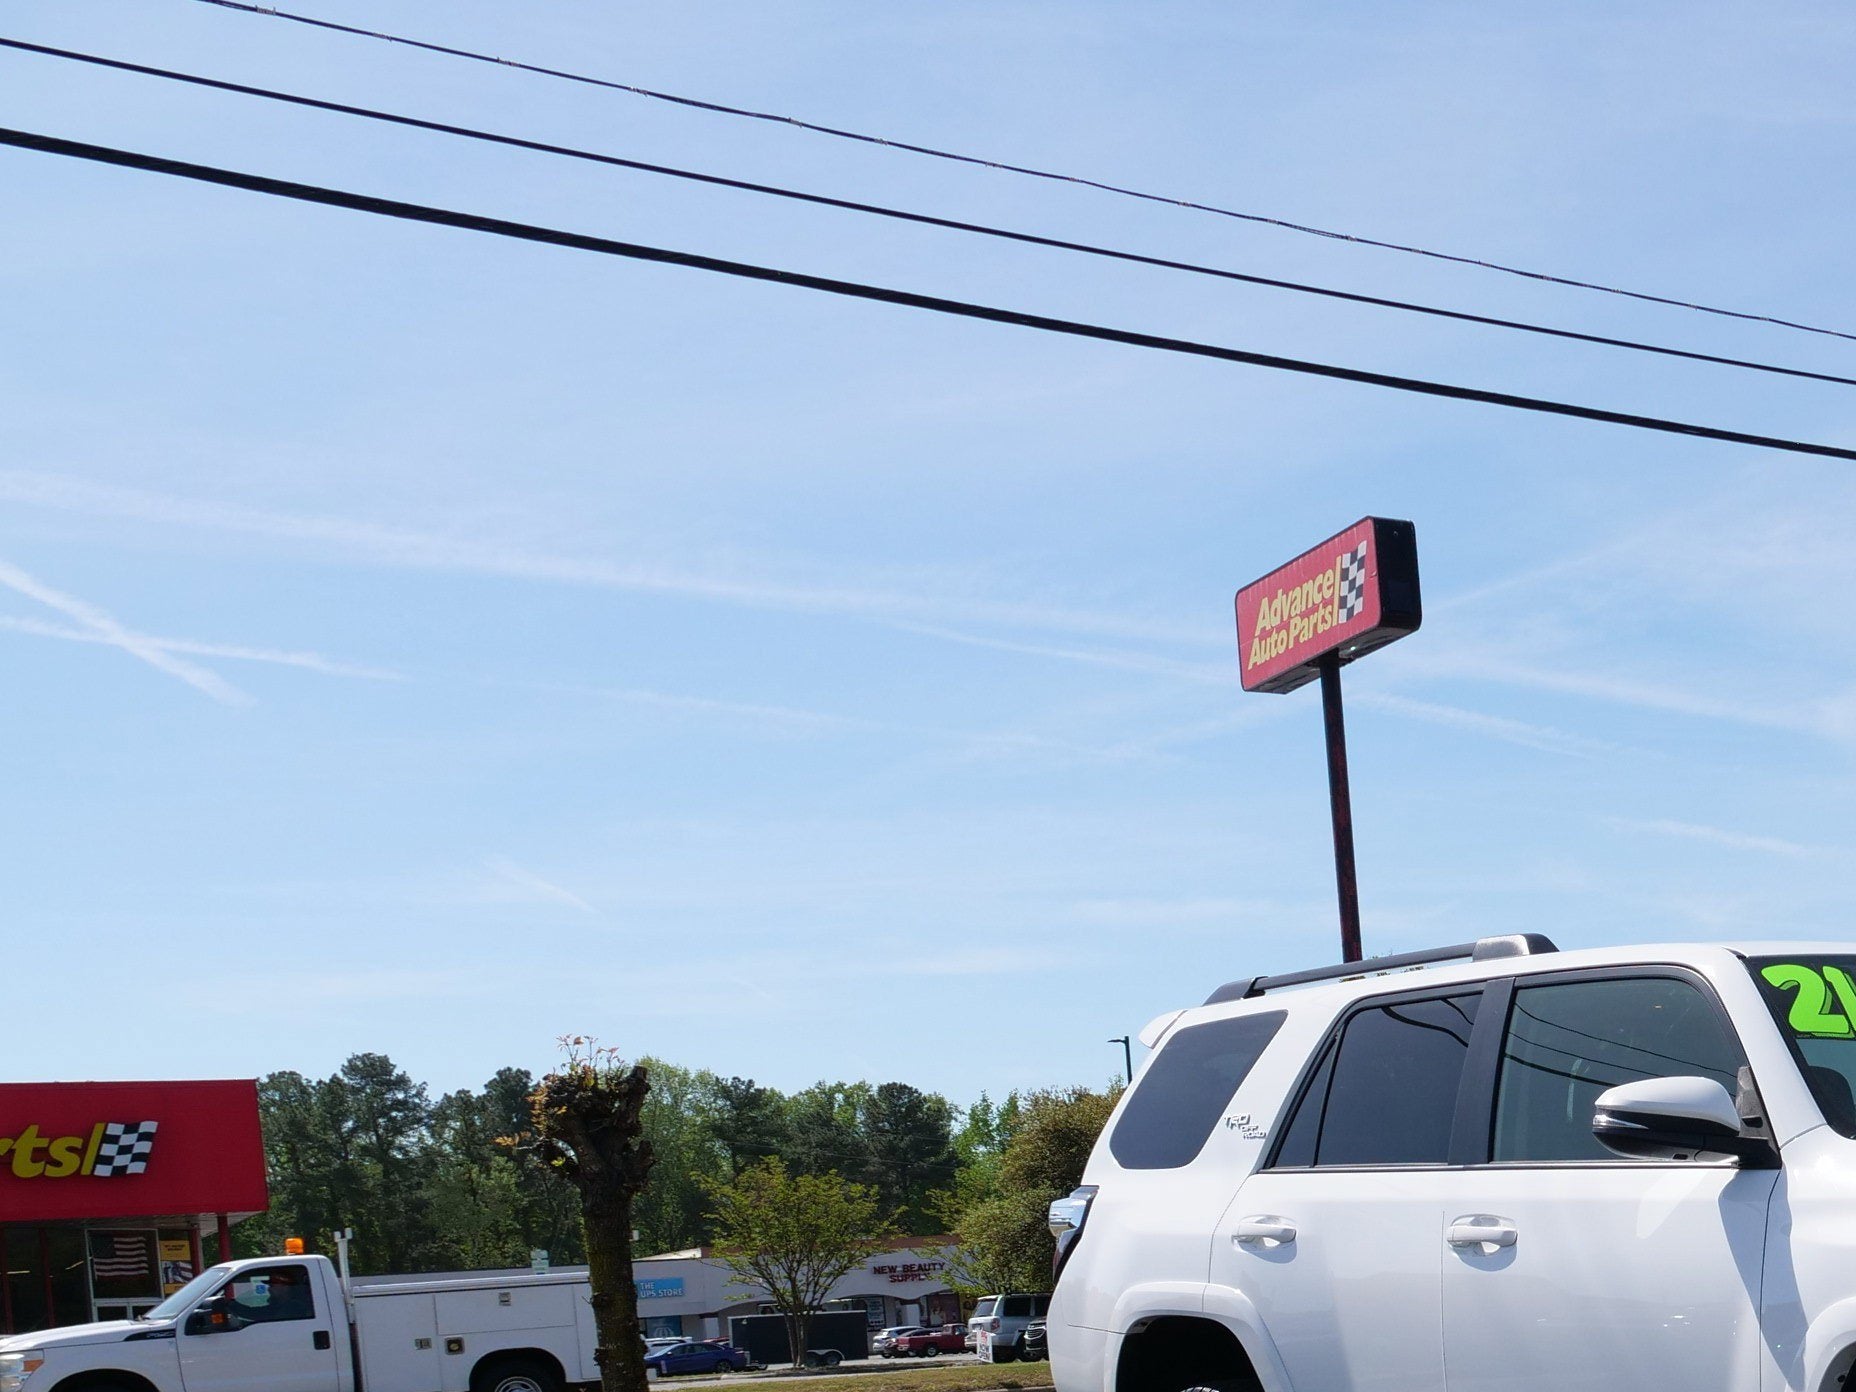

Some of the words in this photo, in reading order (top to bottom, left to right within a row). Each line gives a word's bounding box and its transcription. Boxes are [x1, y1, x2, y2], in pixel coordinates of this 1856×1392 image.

[1255, 569, 1334, 637] Advance
[1248, 627, 1288, 670] Auto
[1288, 603, 1333, 649] Parts
[873, 1265, 898, 1275] NEW
[901, 1262, 945, 1273] BEAUTY
[640, 1282, 655, 1290] THE
[640, 1289, 657, 1298] UPS
[658, 1288, 684, 1297] STORE
